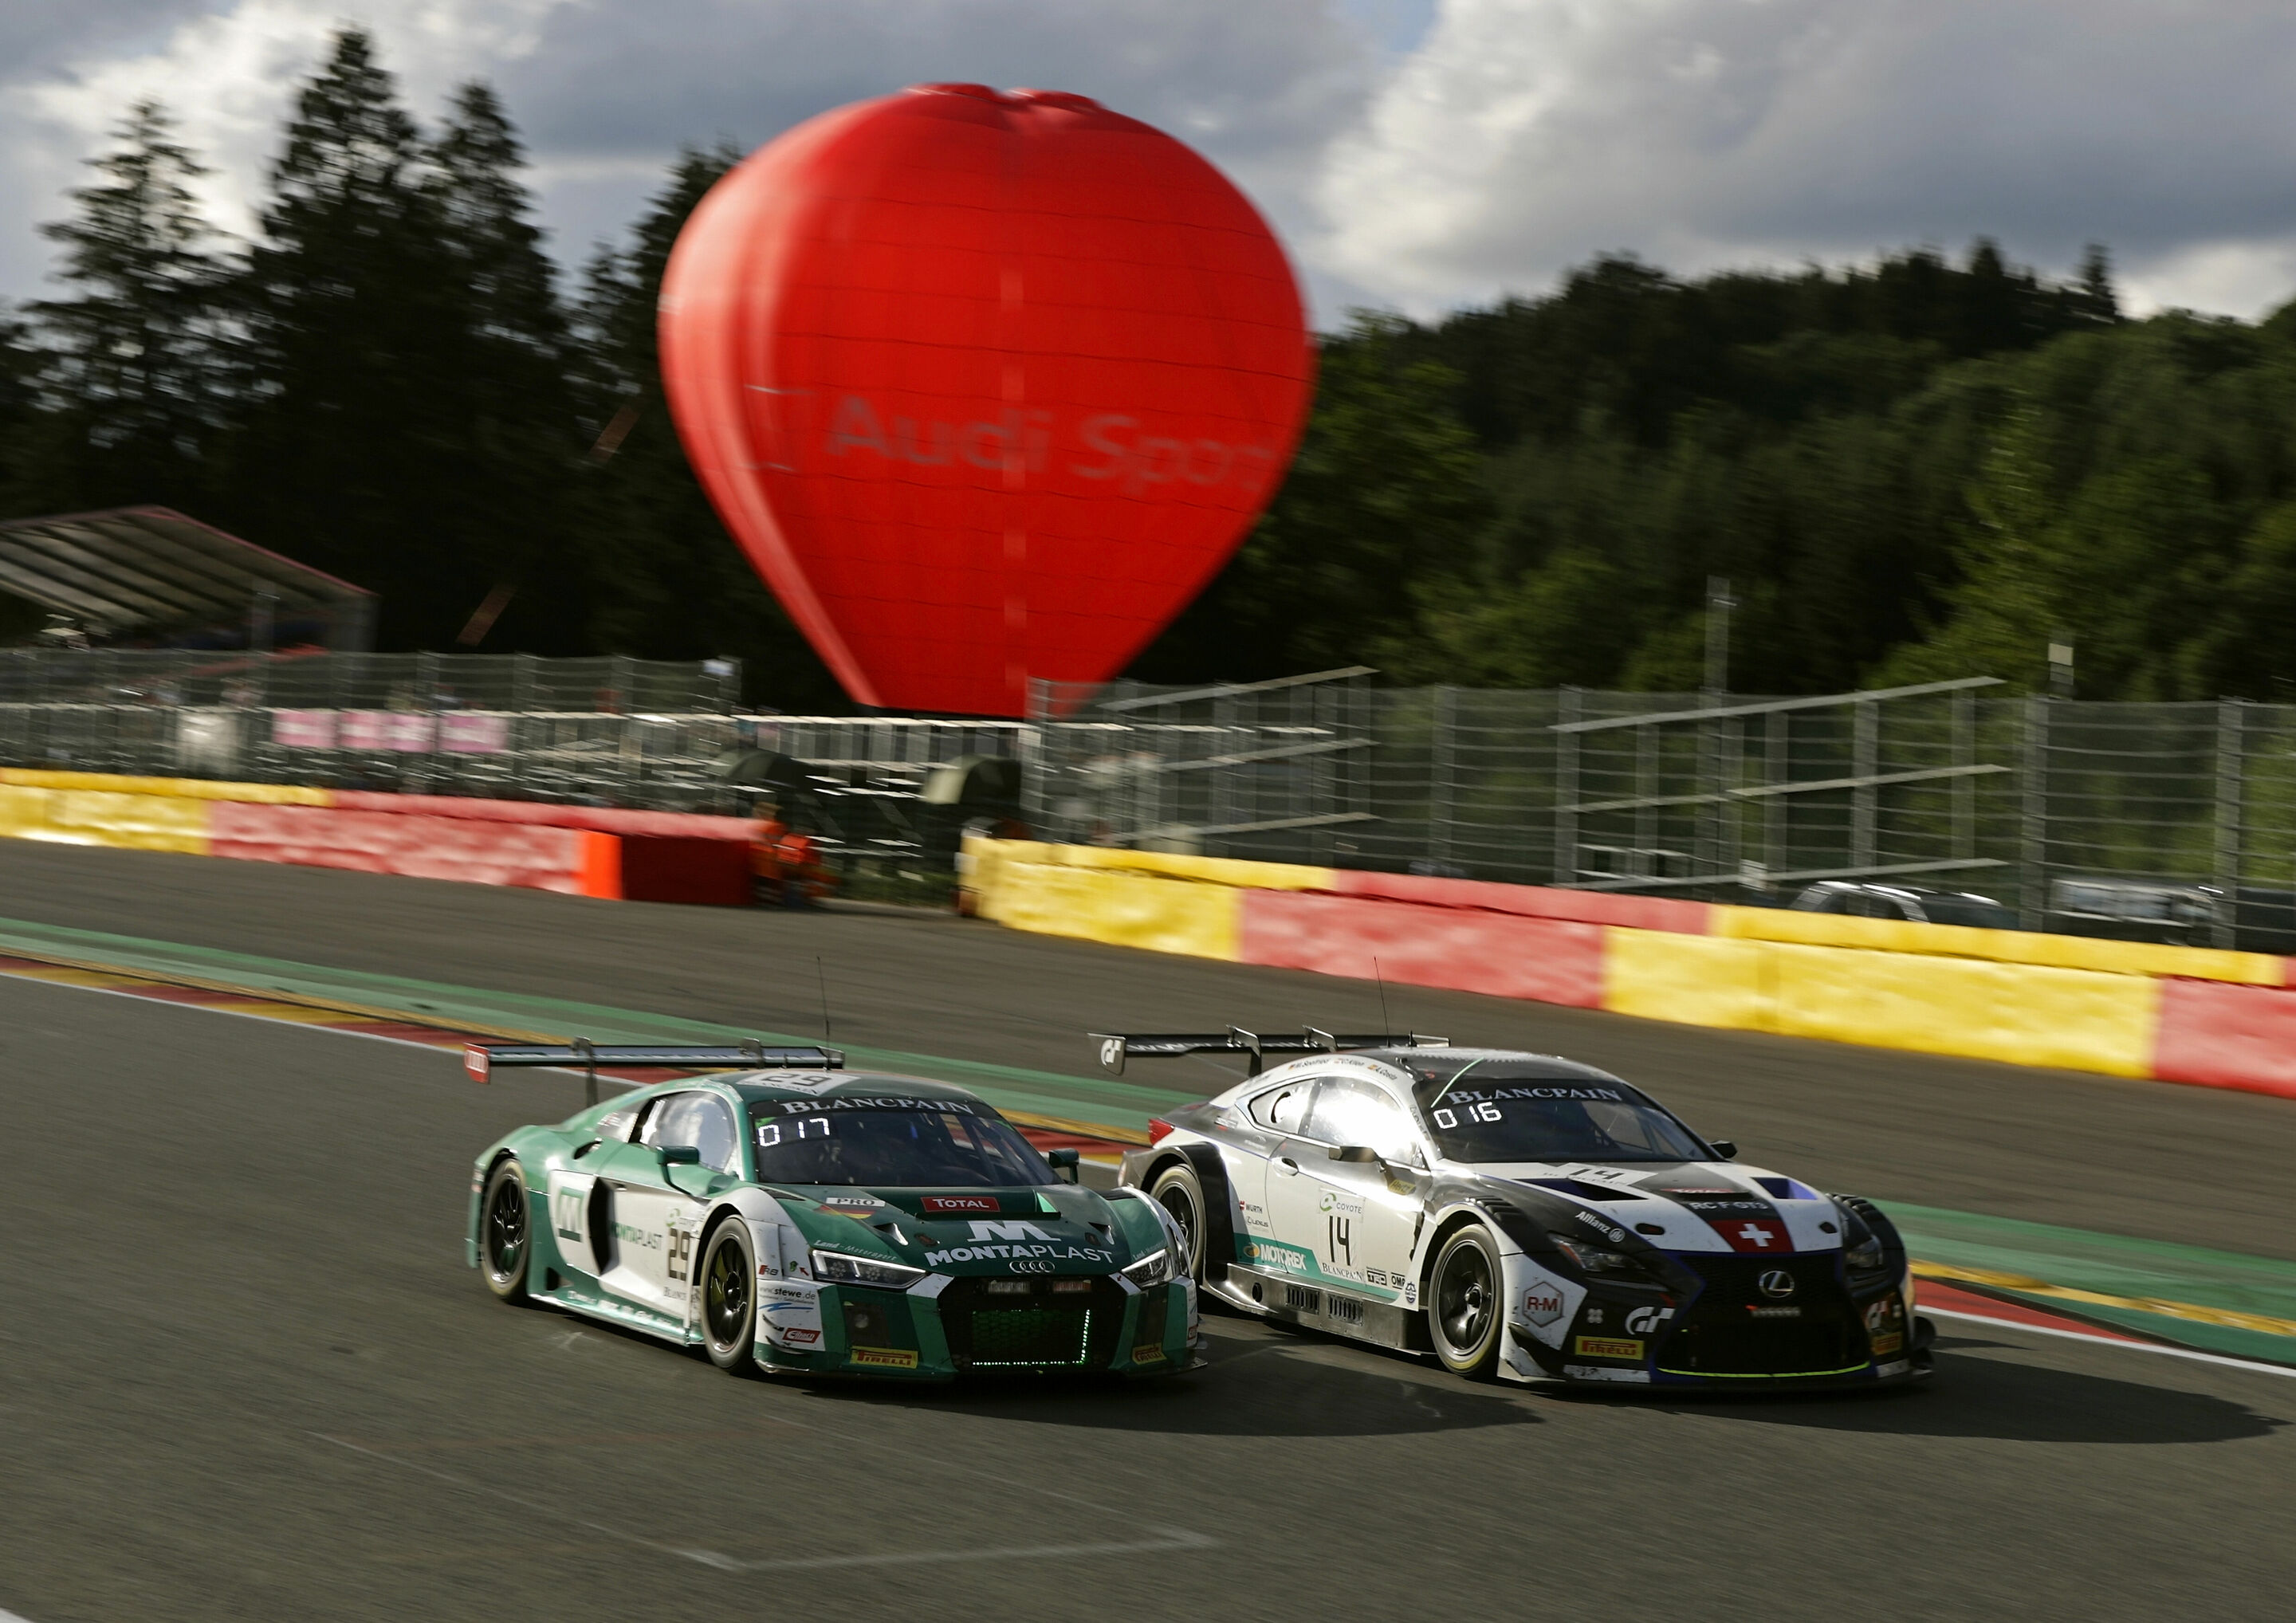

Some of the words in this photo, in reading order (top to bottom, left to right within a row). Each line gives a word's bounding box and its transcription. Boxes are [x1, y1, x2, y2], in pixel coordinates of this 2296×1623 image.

[824, 395, 1054, 475] Audi
[1447, 1087, 1622, 1105] BLANCPAIN
[780, 1098, 975, 1115] BLANCPAIN
[931, 1198, 990, 1208] TOTAL
[1335, 1202, 1362, 1214] COYOTE
[1575, 1211, 1611, 1235] Allianz
[1329, 1215, 1351, 1267] 14
[924, 1245, 1114, 1267] MONTAPLAST
[1260, 1244, 1307, 1271] MOTOREX
[1322, 1263, 1364, 1282] BLANCPAIN
[1527, 1295, 1558, 1311] R-M
[1582, 1340, 1638, 1354] PIRELLI
[857, 1350, 912, 1366] PIRELLI
